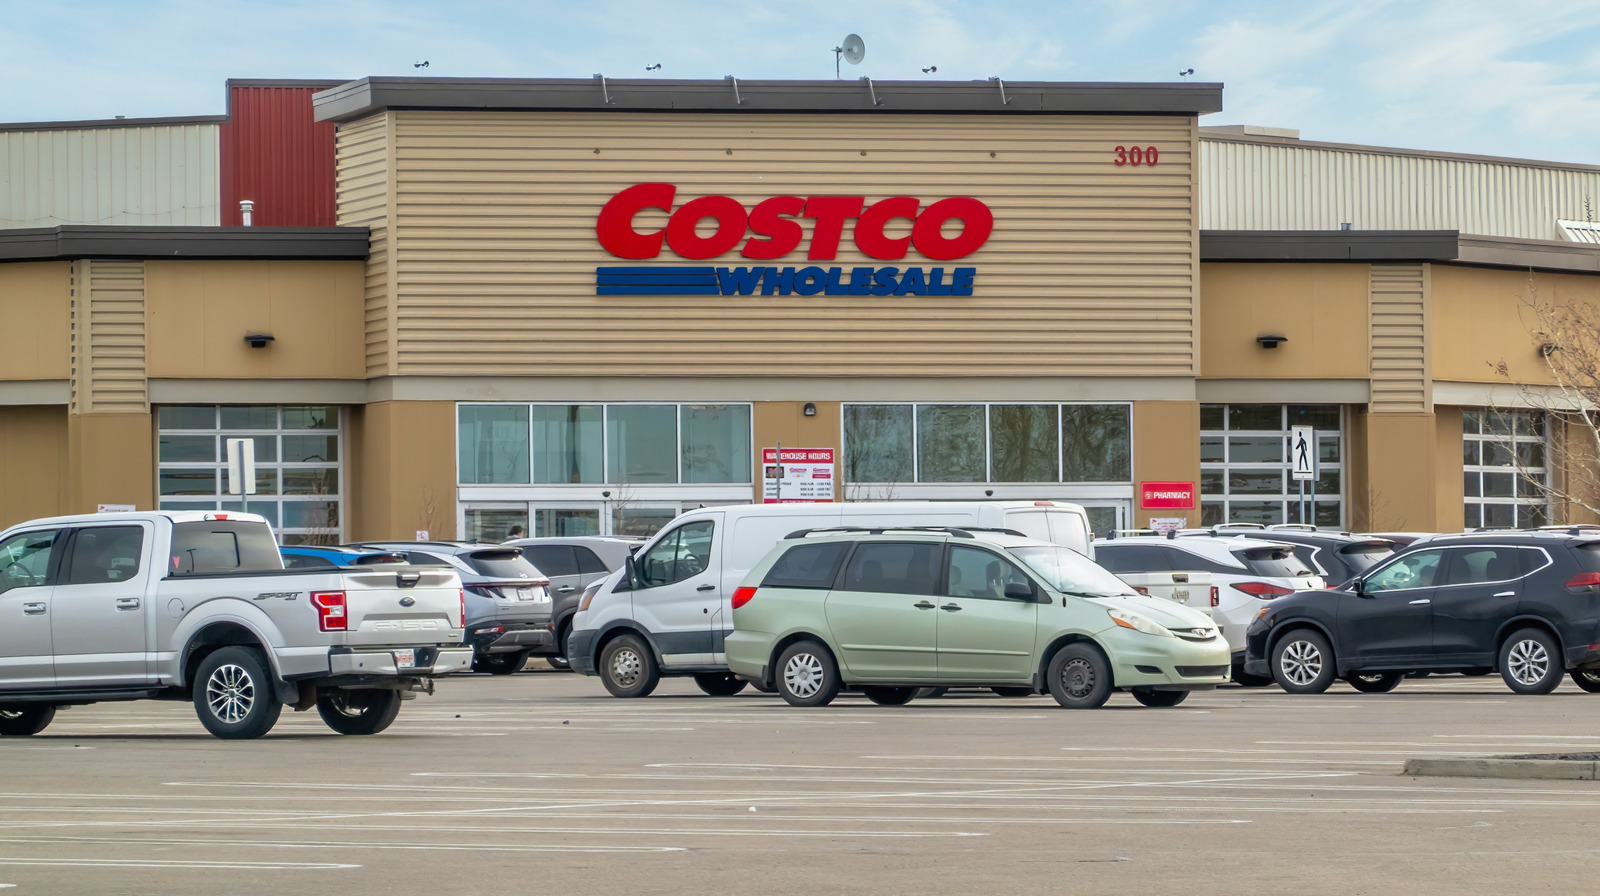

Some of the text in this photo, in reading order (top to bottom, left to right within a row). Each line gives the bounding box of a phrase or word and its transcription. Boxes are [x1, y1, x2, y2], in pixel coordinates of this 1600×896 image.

[1114, 146, 1158, 166] 300
[596, 182, 993, 260] COSTCO
[716, 267, 976, 296] WHOLESALE
[765, 452, 831, 460] WAEHOUSE HOURS
[1153, 491, 1191, 499] PHARMACY
[252, 591, 303, 601] SPORT
[1171, 587, 1190, 601] Jeep
